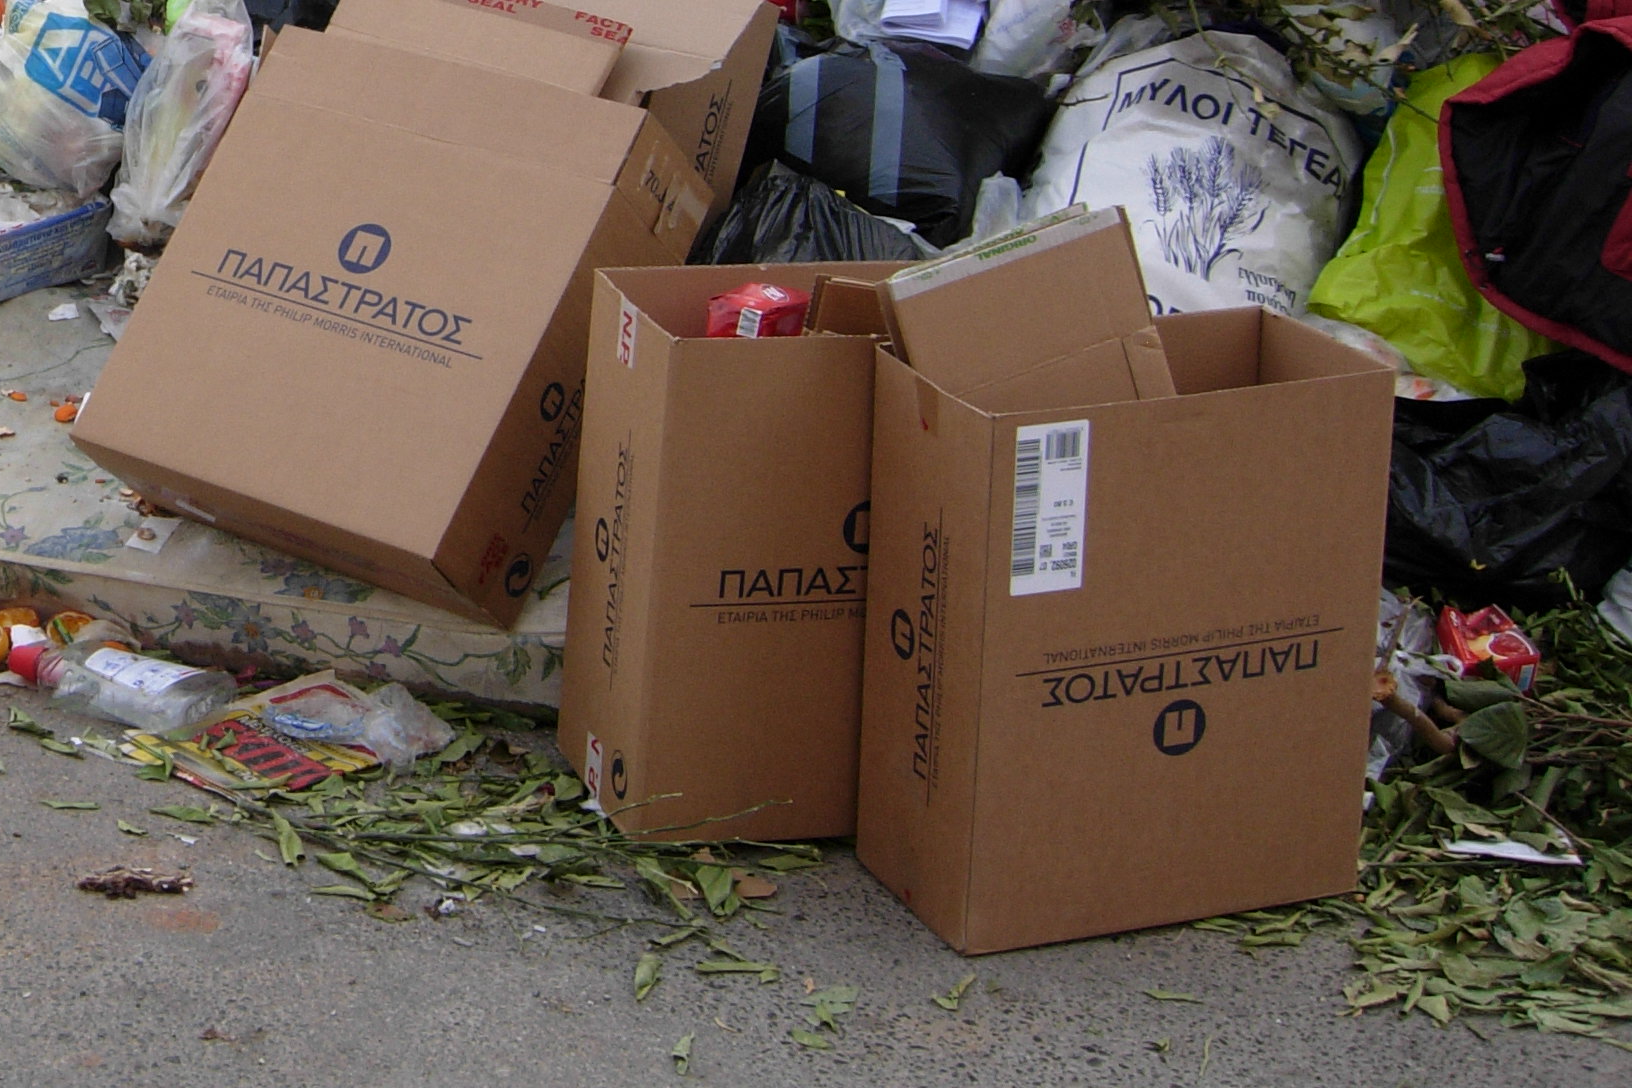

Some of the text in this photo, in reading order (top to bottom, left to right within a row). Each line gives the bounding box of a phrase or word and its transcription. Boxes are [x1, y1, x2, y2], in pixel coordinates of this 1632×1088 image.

[694, 92, 724, 174] ΑΤΟΣ
[1118, 78, 1235, 126] ΜΥΛΟΙ
[975, 233, 1039, 263] ORIGINAL
[206, 284, 453, 369] ΕΤΑΙΡΙΑ ΤΗΣ PHILIP MORRIS INTERNATIONAL
[216, 248, 473, 346] ΠΑΠΑΣΤΡΑΤΟΣ
[601, 441, 629, 667] ΠΑΠΑΣΤΡΑΤΟΣ
[718, 611, 768, 625] ΕΤΑΙΡΙΑ
[771, 609, 797, 623] ΤΗΣ
[800, 607, 846, 621] PHILIP
[912, 520, 939, 781] ΠΑΠΑΣΤΡΑΤΟΣ
[1042, 614, 1321, 666] ΕΤΑΙΡΙΑ ΤΗΣ PHILIP MORRIS INTERNATIONAL
[1041, 639, 1319, 708] ΠΑΠΑΣΤΡΑΤΟΣ
